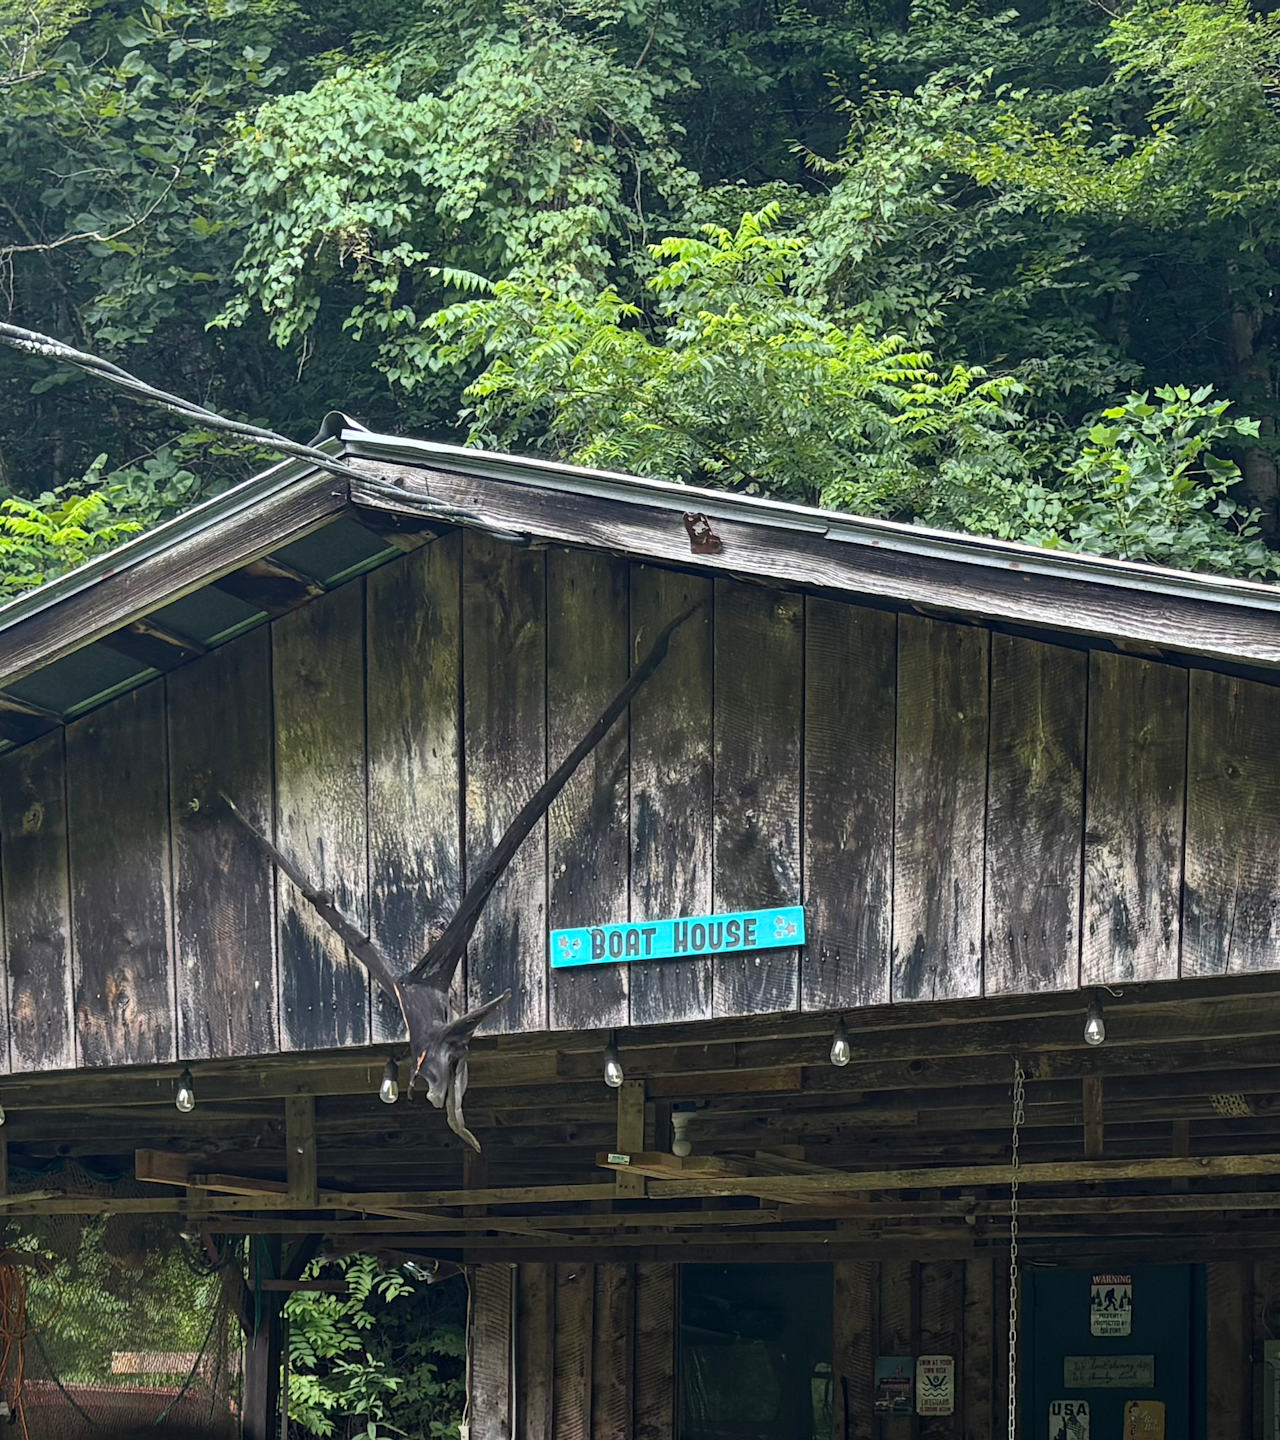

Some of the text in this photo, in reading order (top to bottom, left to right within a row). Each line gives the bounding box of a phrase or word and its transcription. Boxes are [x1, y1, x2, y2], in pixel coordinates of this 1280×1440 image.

[590, 918, 757, 960] BOAT HOUSE
[1092, 1275, 1131, 1283] WARNING
[1052, 1403, 1087, 1416] USA
